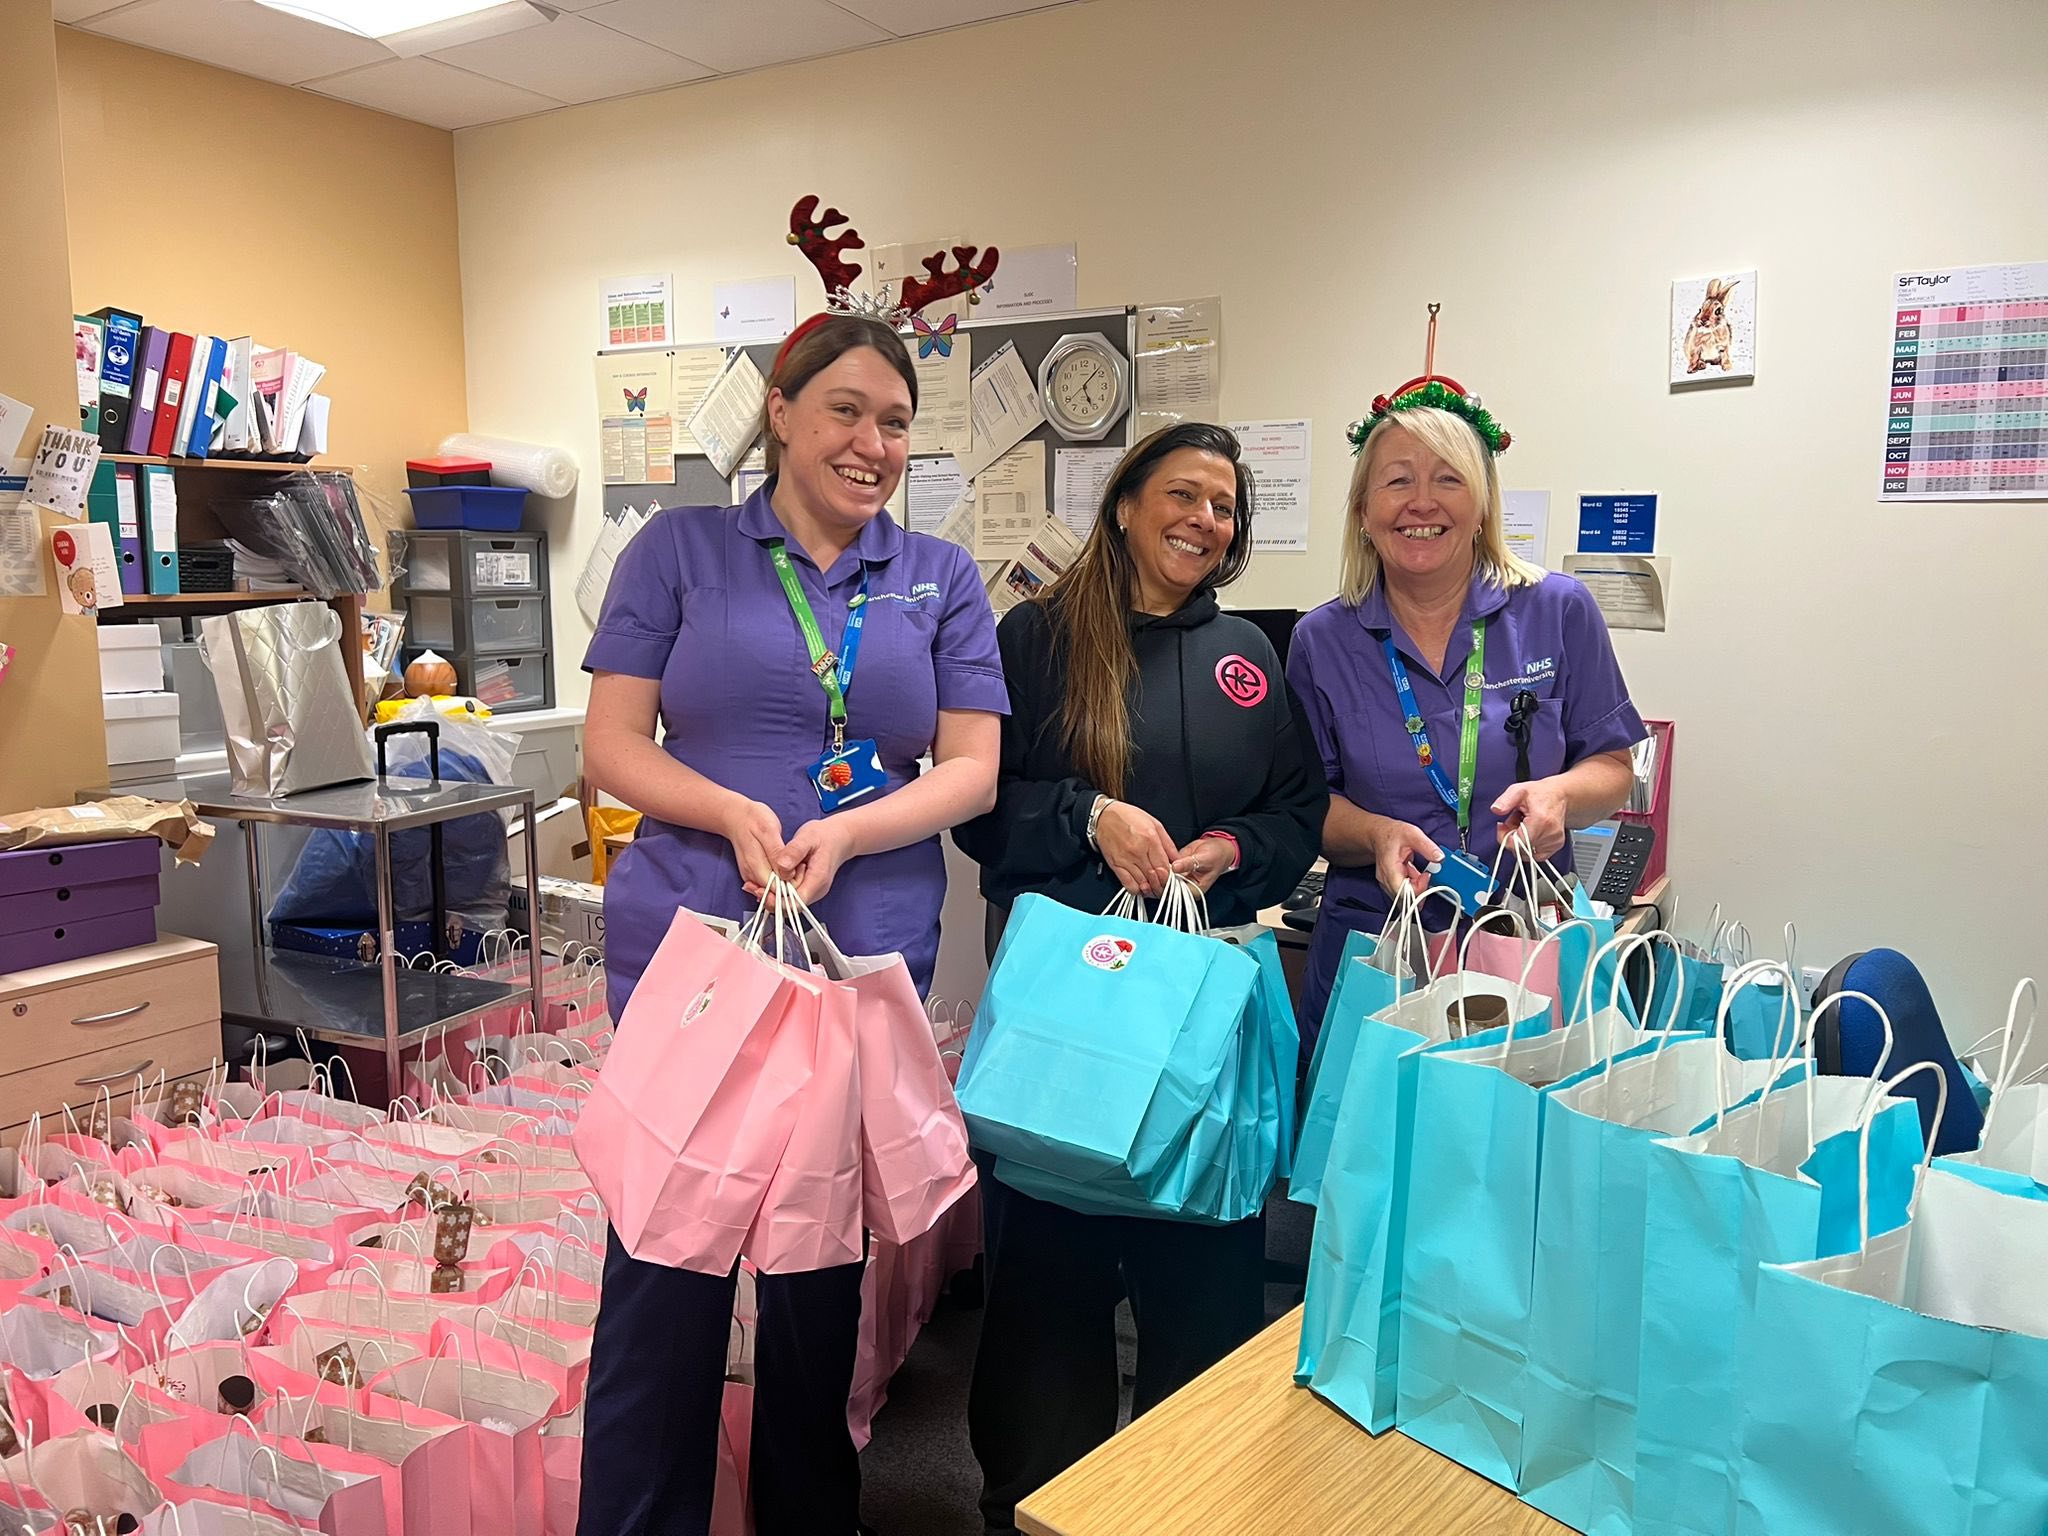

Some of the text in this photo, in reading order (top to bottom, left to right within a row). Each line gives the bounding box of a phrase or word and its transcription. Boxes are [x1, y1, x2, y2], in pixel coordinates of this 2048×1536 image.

[1900, 315, 1917, 323] JAN
[1898, 330, 1916, 338] FEB
[1896, 345, 1917, 353] MAR
[1895, 361, 1914, 369] APR
[1064, 372, 1071, 380] 10
[1894, 376, 1914, 384] MAY
[1893, 391, 1912, 400] JUN
[1892, 407, 1910, 415] JUL
[1890, 422, 1910, 430] AUG
[43, 430, 96, 456] THANK
[1888, 436, 1911, 446] SEPT
[1888, 452, 1908, 460] OCT
[1887, 467, 1907, 475] NOV
[1886, 482, 1905, 490] DEC
[912, 583, 938, 595] NHS
[905, 592, 940, 603] University
[1526, 657, 1552, 675] NHS
